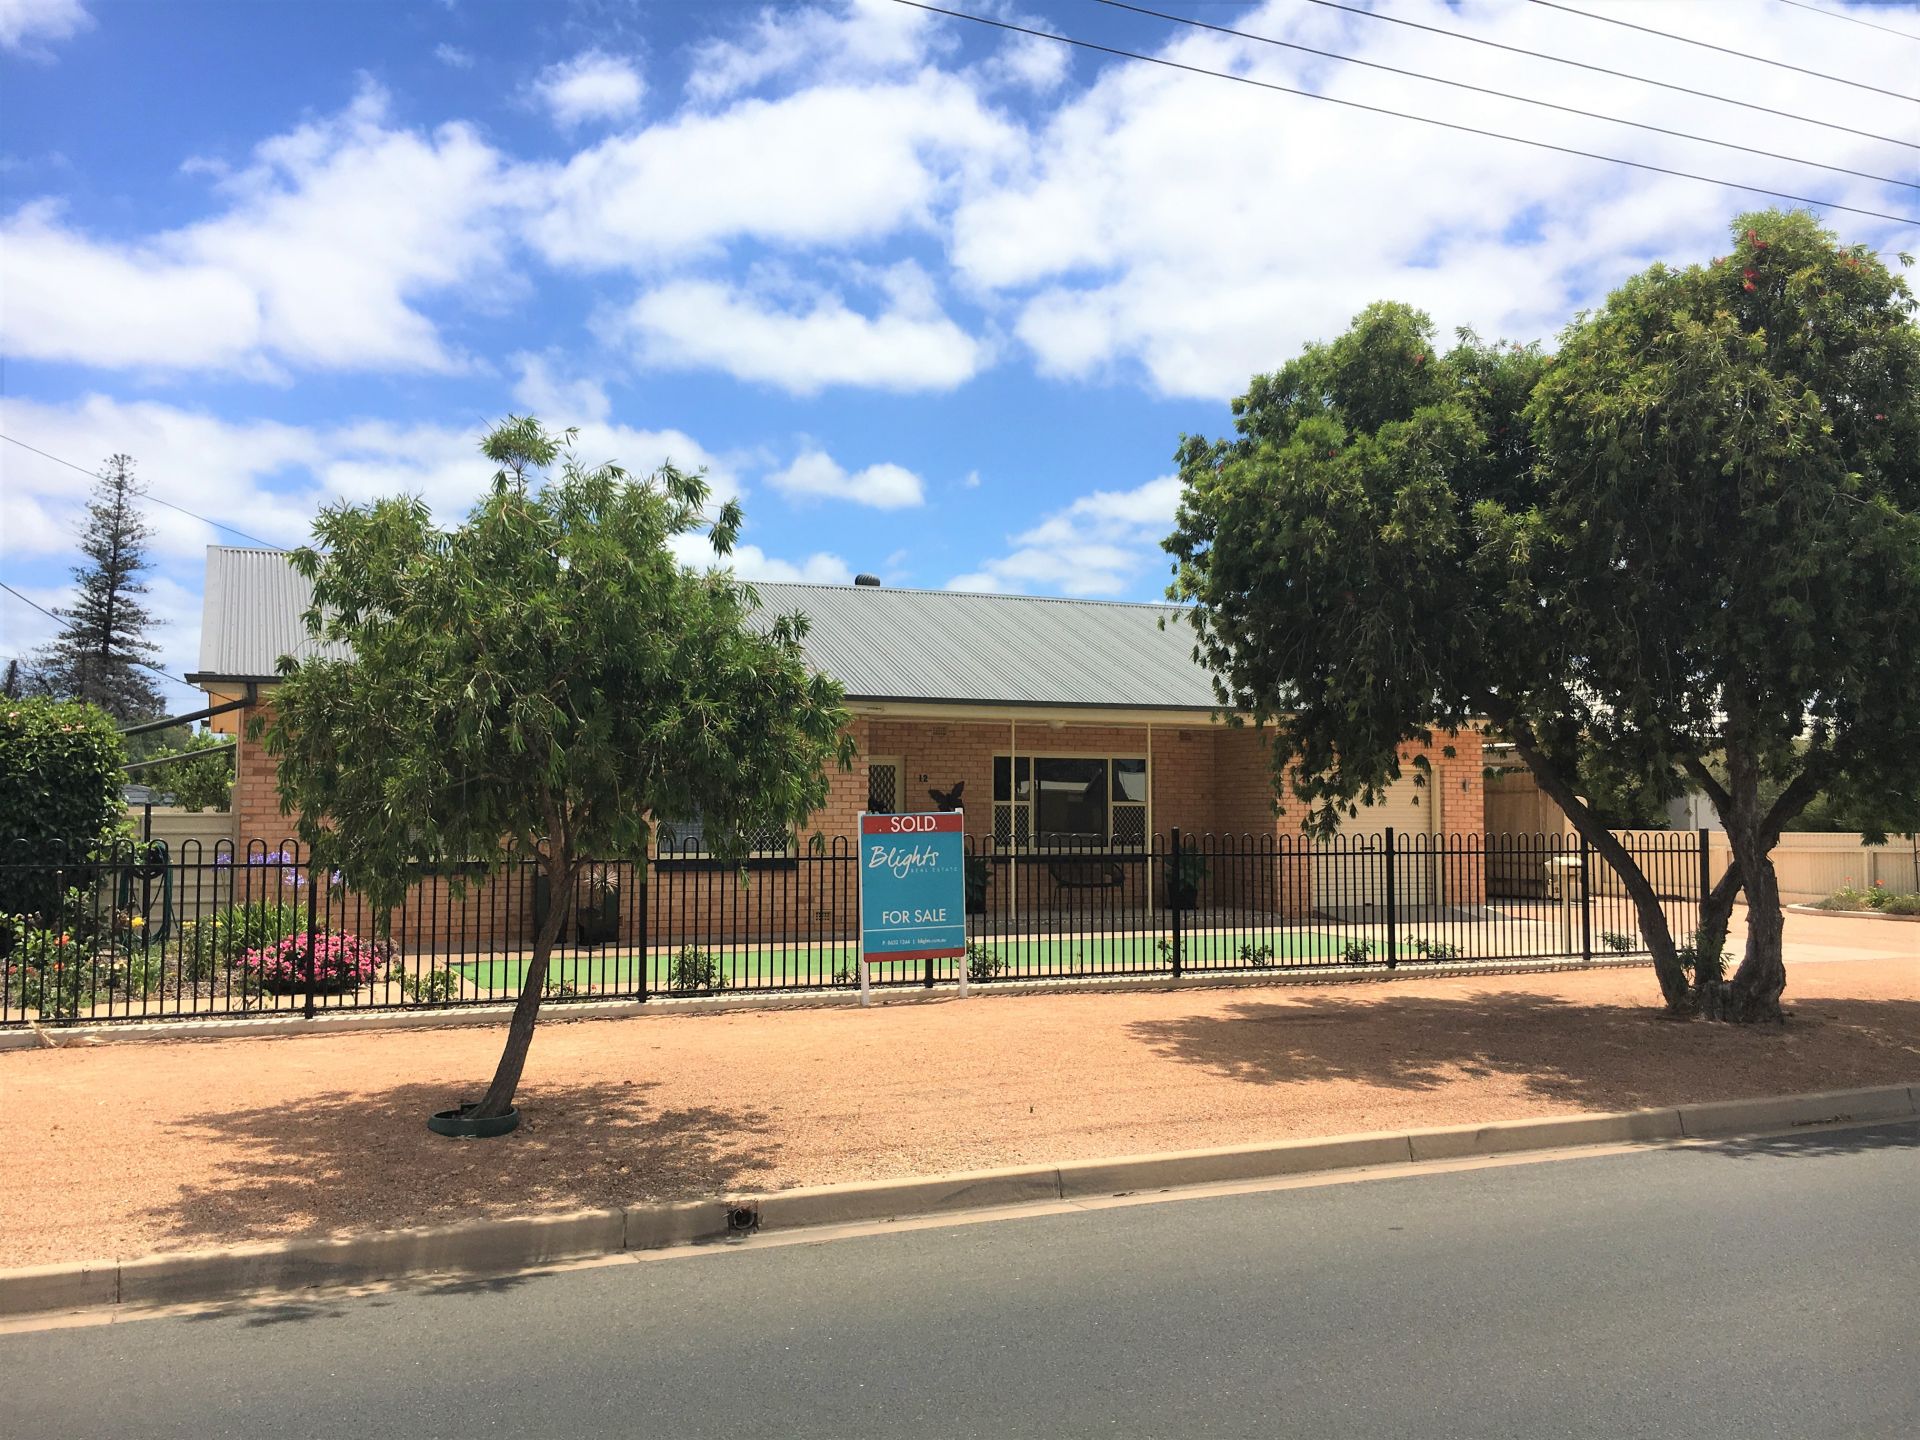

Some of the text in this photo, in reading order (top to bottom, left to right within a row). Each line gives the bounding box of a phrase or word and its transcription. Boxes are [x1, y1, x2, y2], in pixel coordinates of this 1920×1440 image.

[919, 774, 928, 782] 12
[890, 815, 936, 832] SOLD
[868, 845, 939, 879] Blights
[882, 908, 947, 924] FOR SALE
